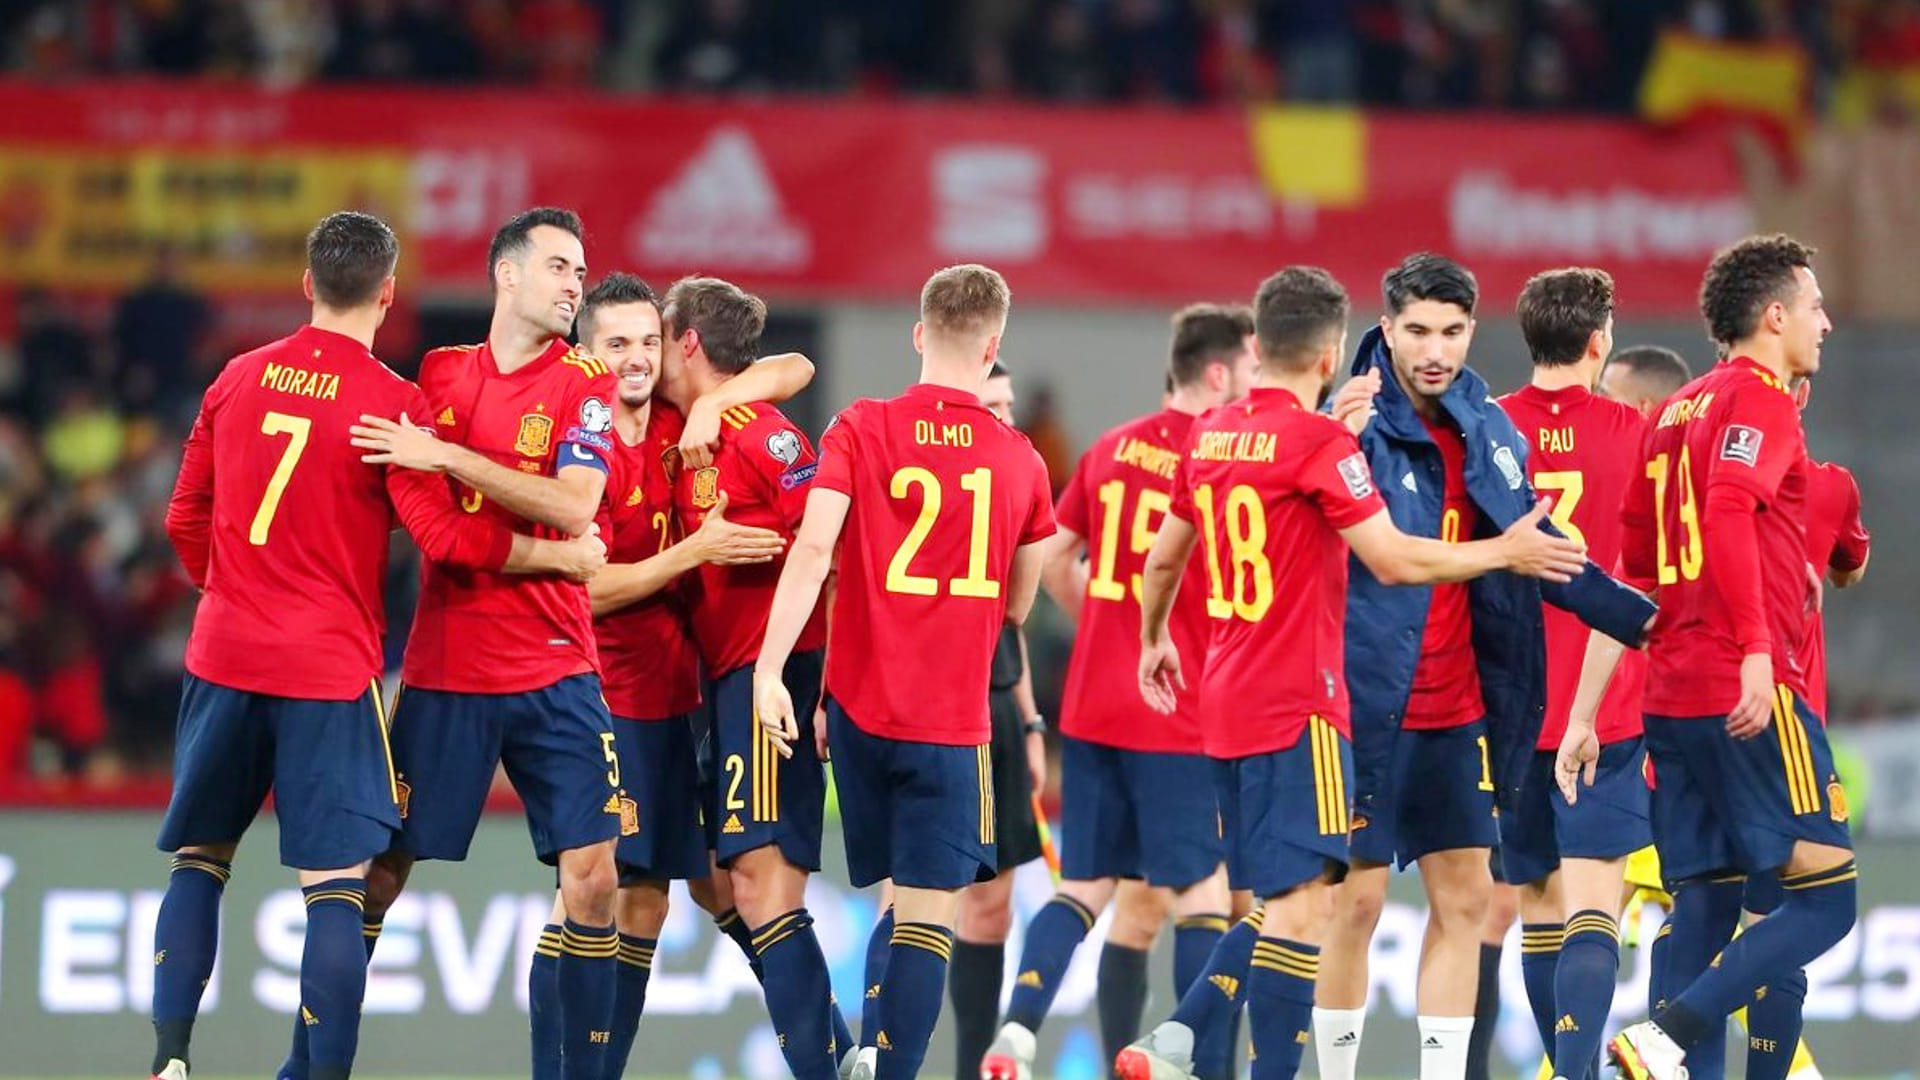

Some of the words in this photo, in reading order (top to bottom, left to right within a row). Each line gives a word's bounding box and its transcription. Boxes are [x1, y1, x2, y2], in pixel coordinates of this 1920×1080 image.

[260, 361, 340, 400] MORATA
[915, 419, 973, 447] OLMO
[1113, 436, 1182, 480] LAPORTE
[1234, 432, 1278, 463] ALBA
[1539, 426, 1575, 453] PAU
[249, 411, 312, 545] 7
[885, 465, 1000, 599] 21
[1088, 479, 1172, 606] 15
[1645, 444, 1704, 586] 19
[1193, 483, 1275, 623] 18
[600, 732, 621, 788] 5
[724, 753, 746, 811] 2
[254, 888, 766, 1015] SEVILA
